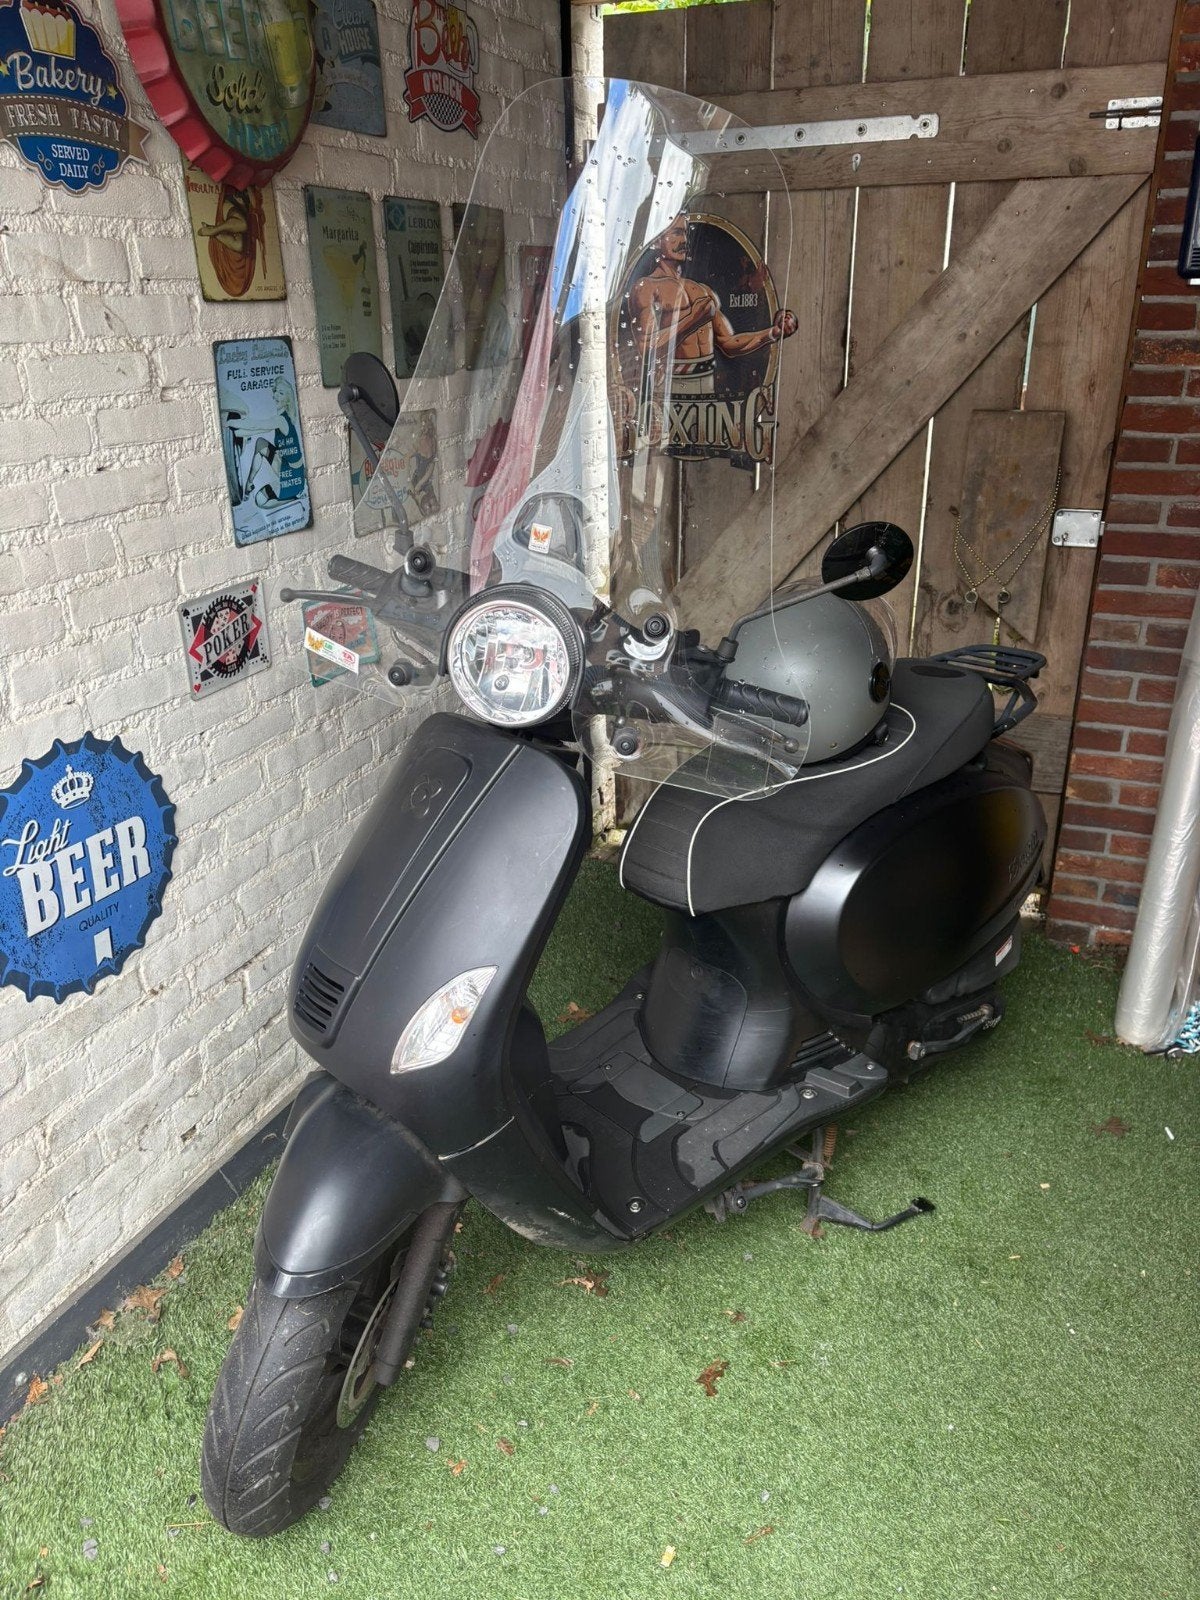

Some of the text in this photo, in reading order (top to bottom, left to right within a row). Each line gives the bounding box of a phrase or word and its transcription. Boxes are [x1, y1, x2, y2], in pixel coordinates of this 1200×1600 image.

[338, 27, 373, 56] HOUSE
[7, 51, 108, 106] Bakery
[6, 103, 122, 142] FRESH TASTY
[51, 143, 91, 162] SERVED
[59, 162, 90, 179] DAILY
[322, 225, 360, 243] Margarita
[408, 216, 440, 230] LEBLON
[227, 365, 285, 380] FULL SERVICE
[240, 378, 275, 392] GARAGE
[203, 612, 250, 665] POKER
[2, 819, 72, 877] Light
[17, 816, 151, 938] BEER
[78, 901, 120, 932] QUALITY
